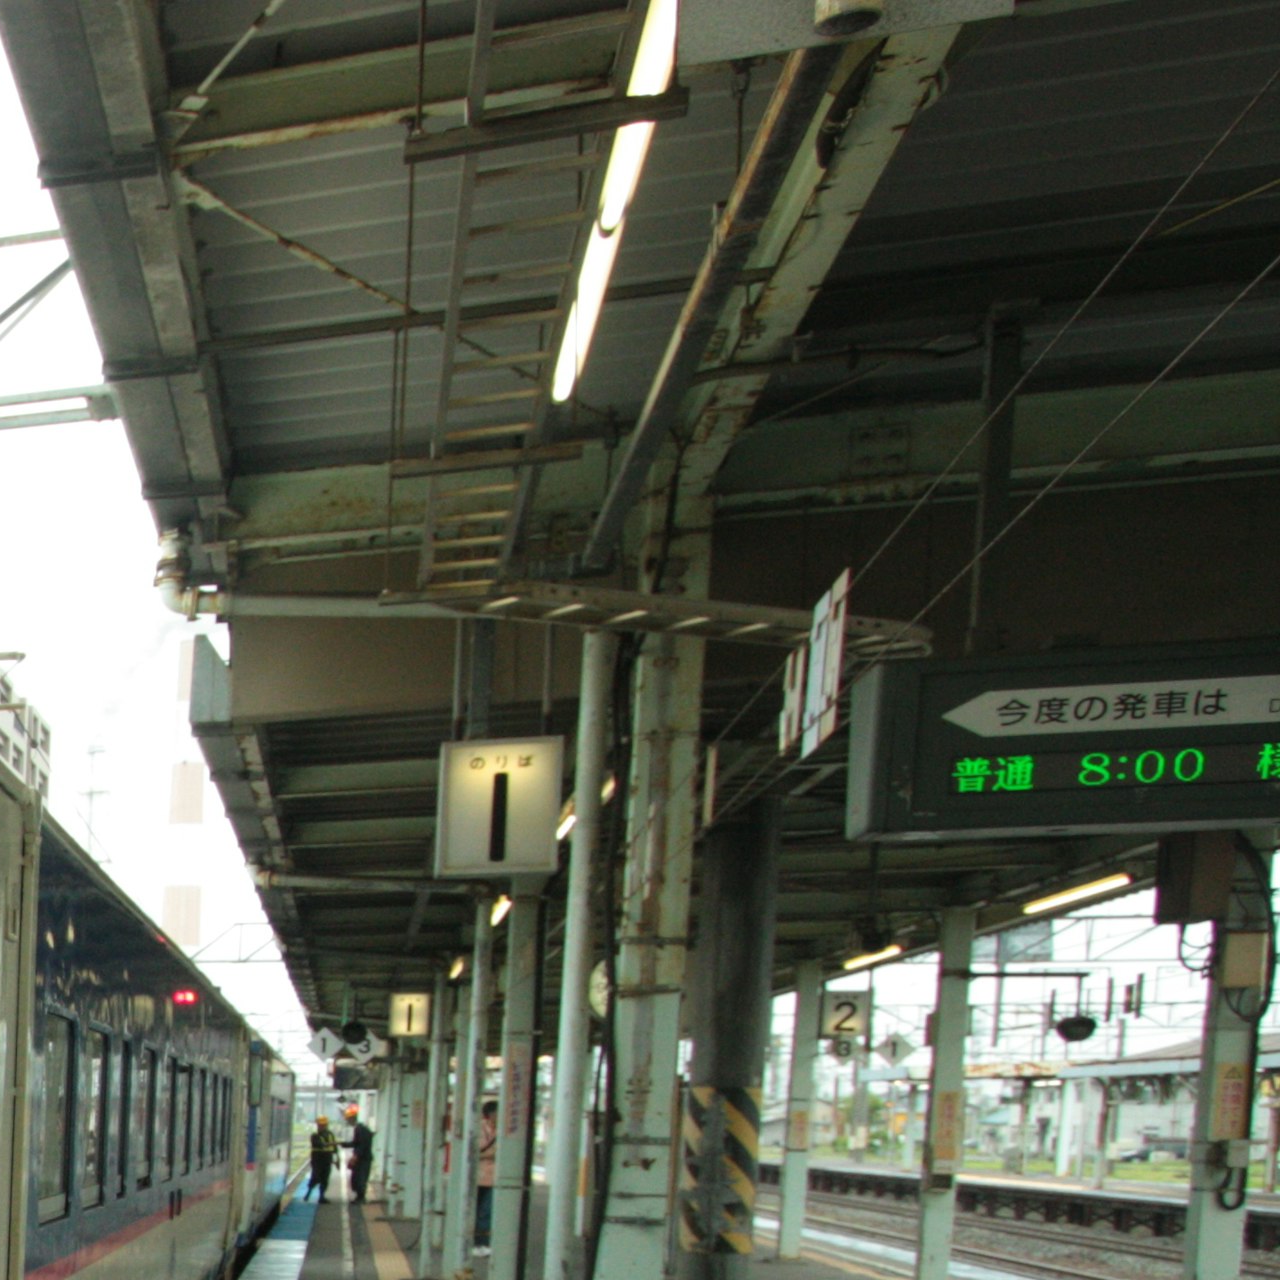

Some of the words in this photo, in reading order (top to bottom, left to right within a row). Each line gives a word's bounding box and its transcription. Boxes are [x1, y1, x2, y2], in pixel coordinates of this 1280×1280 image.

[996, 688, 1228, 727] 今度の発車は
[469, 755, 535, 770] のりば
[951, 754, 1035, 793] 普通
[1077, 748, 1205, 787] 8:00
[489, 772, 509, 862] 1
[833, 1001, 858, 1032] 2
